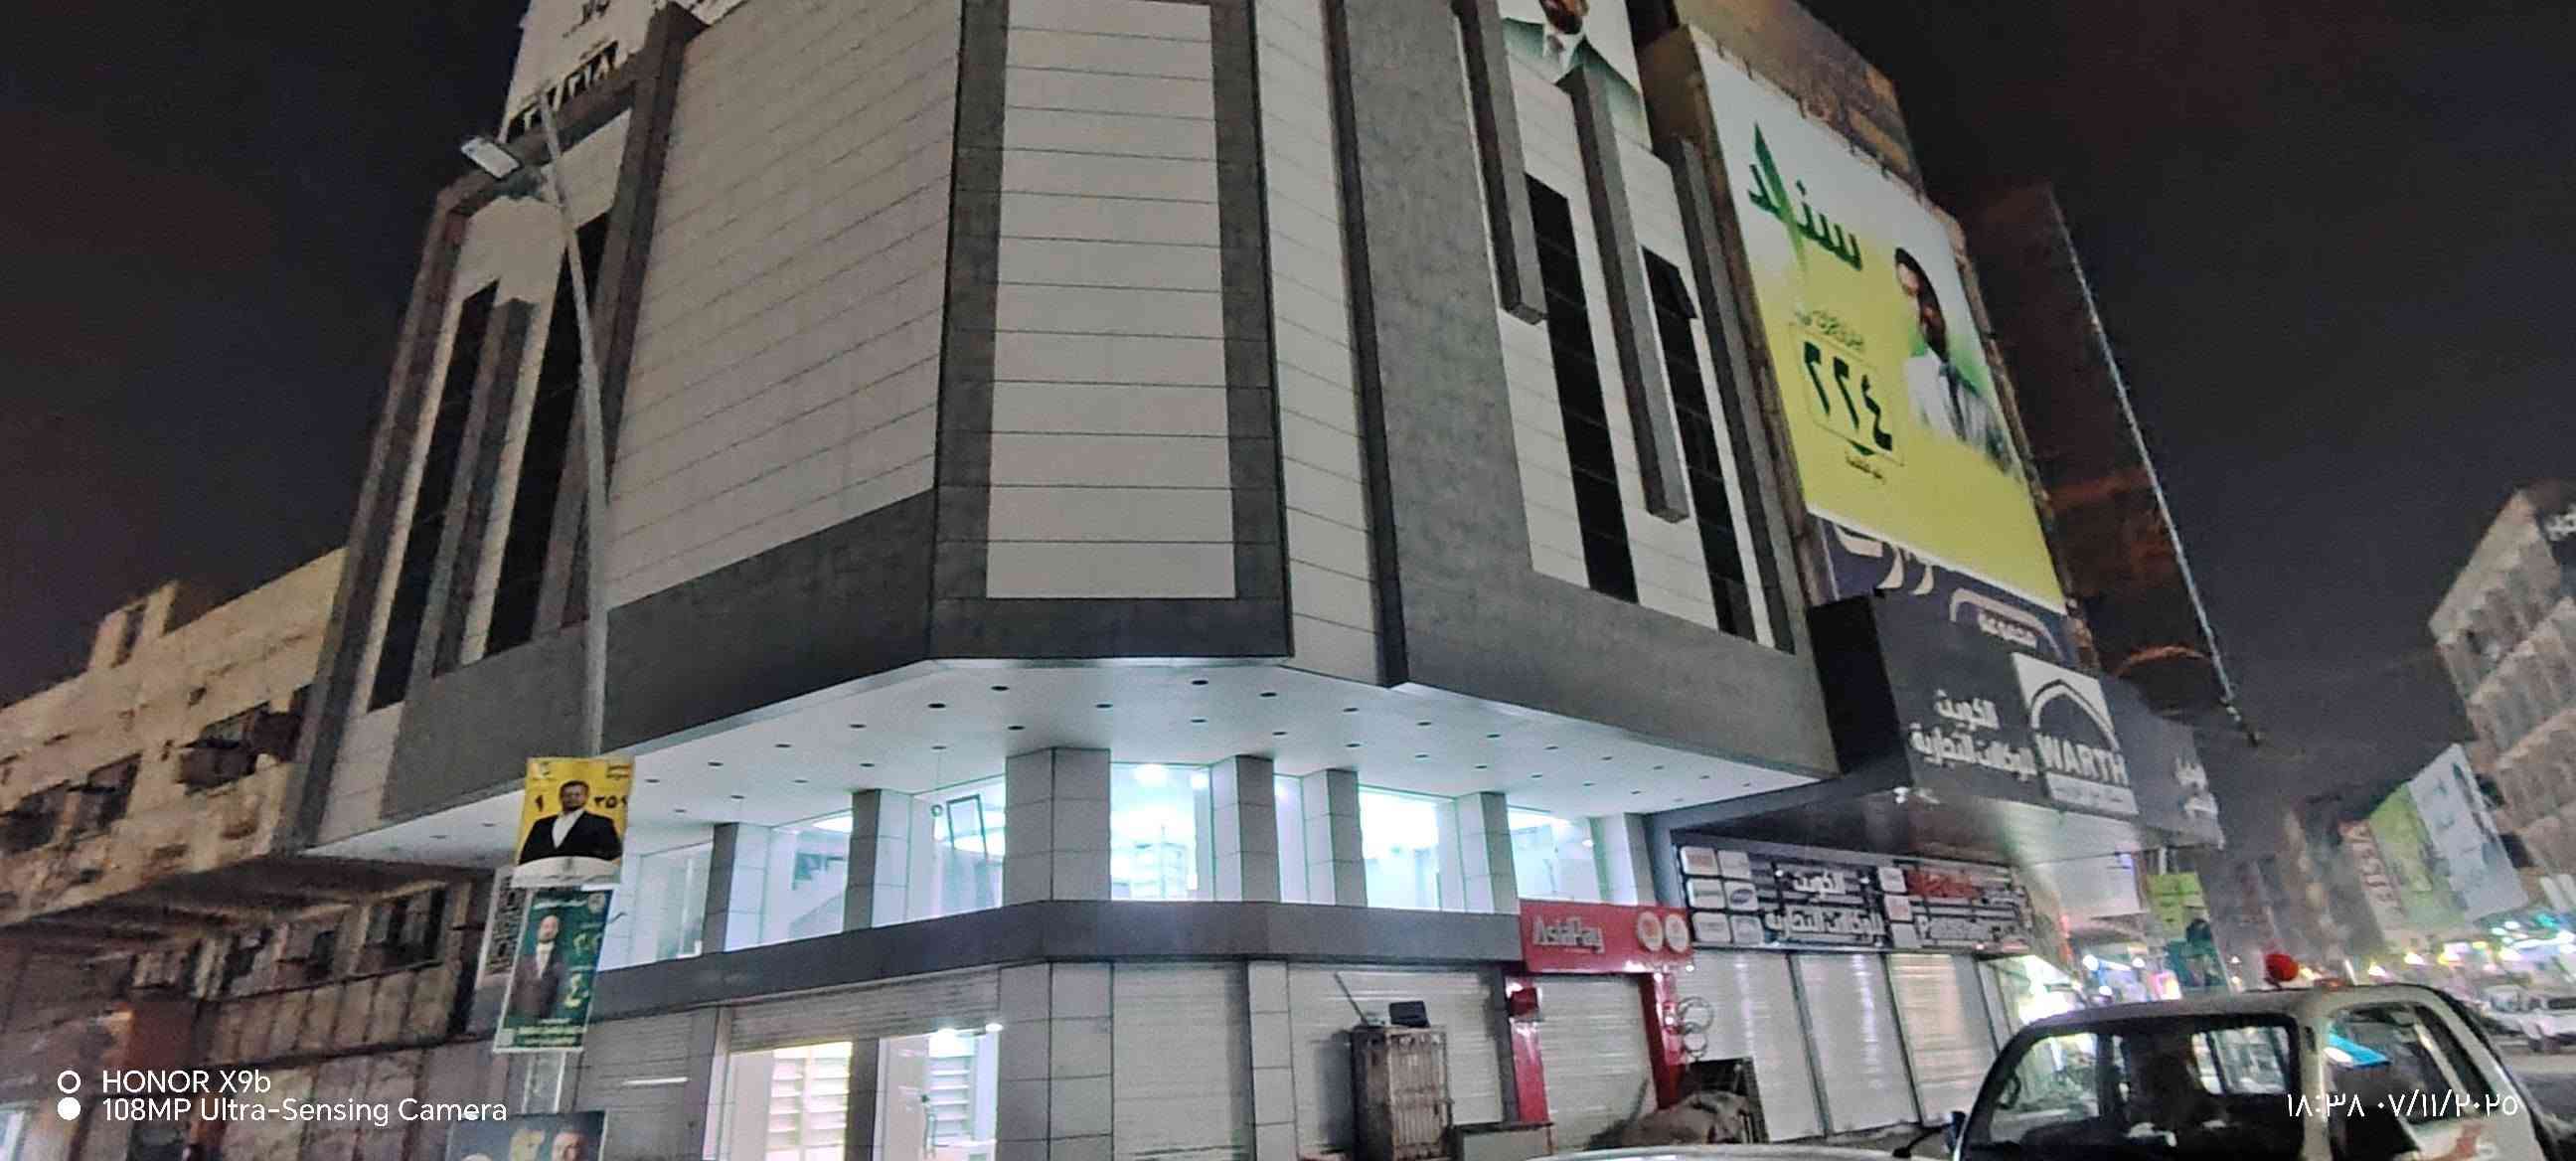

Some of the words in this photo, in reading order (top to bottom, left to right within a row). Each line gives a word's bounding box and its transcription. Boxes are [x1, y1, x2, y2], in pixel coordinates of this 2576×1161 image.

[1803, 341, 1893, 452] ٢٢٤
[1934, 689, 2000, 731] الكويت
[2035, 733, 2130, 787] WARTH
[1792, 869, 1847, 900] الكويت
